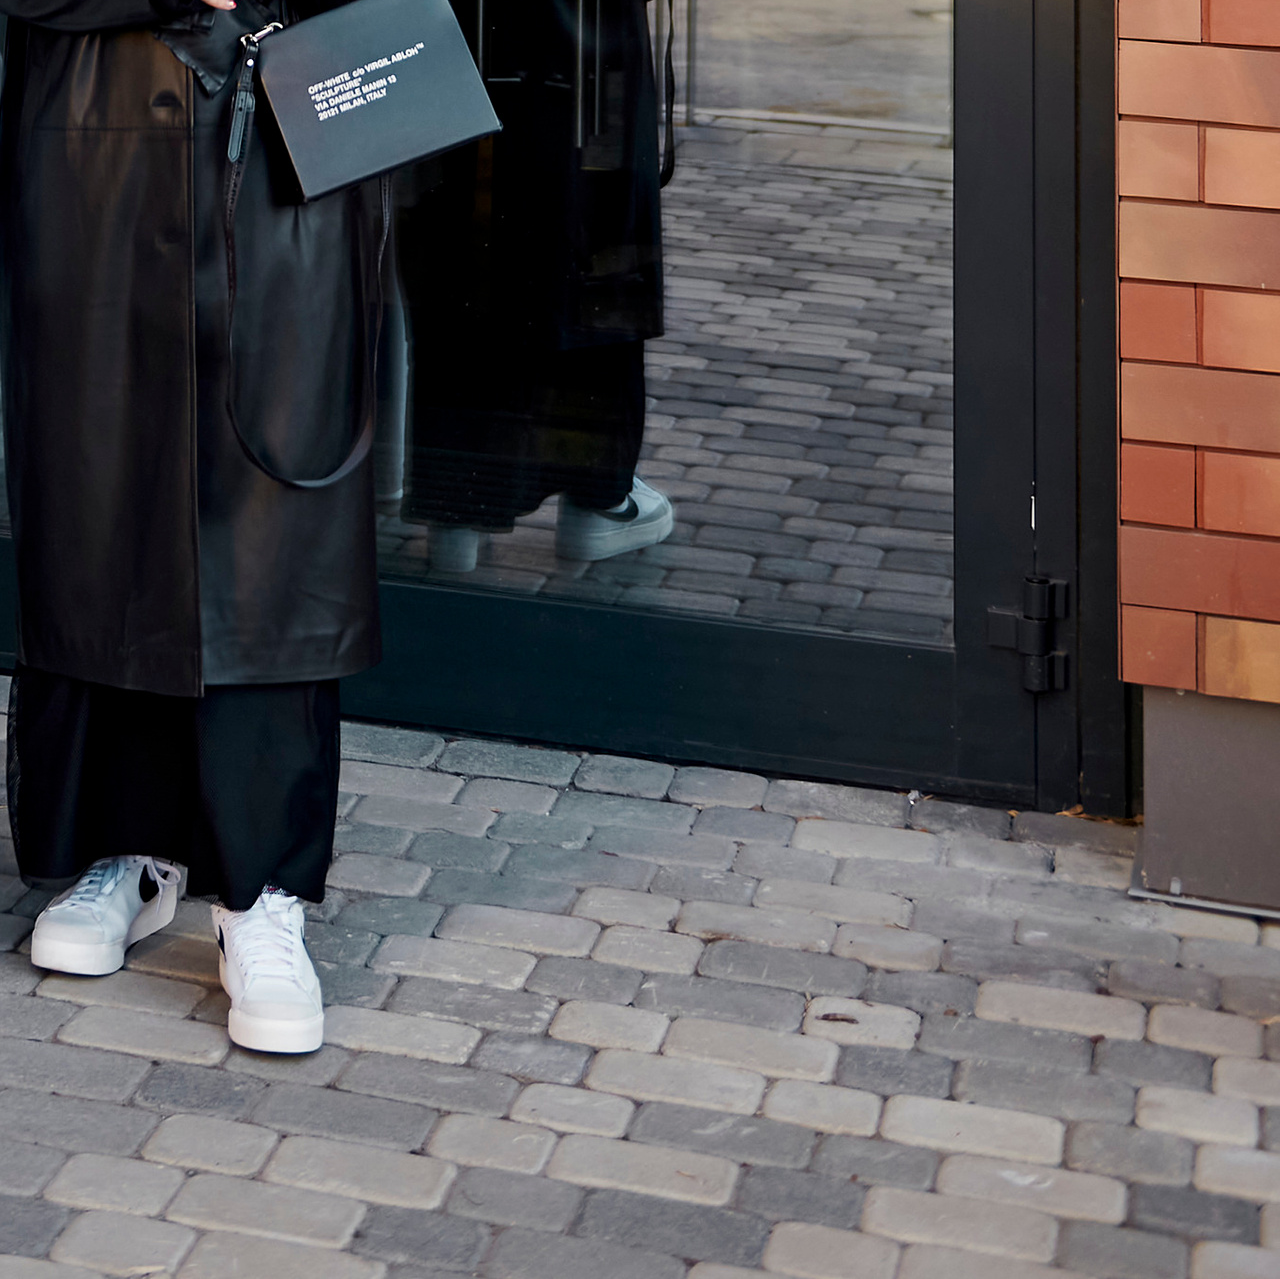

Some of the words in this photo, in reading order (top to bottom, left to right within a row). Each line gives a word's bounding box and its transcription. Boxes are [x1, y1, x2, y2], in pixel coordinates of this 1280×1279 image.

[308, 72, 351, 95] OFF-WHITE
[364, 57, 391, 72] VIRGIL
[314, 101, 329, 112] VIA
[329, 88, 362, 106] DANIELE
[361, 78, 387, 94] MANIN
[318, 106, 339, 121] 20121
[366, 88, 387, 102] ITALY
